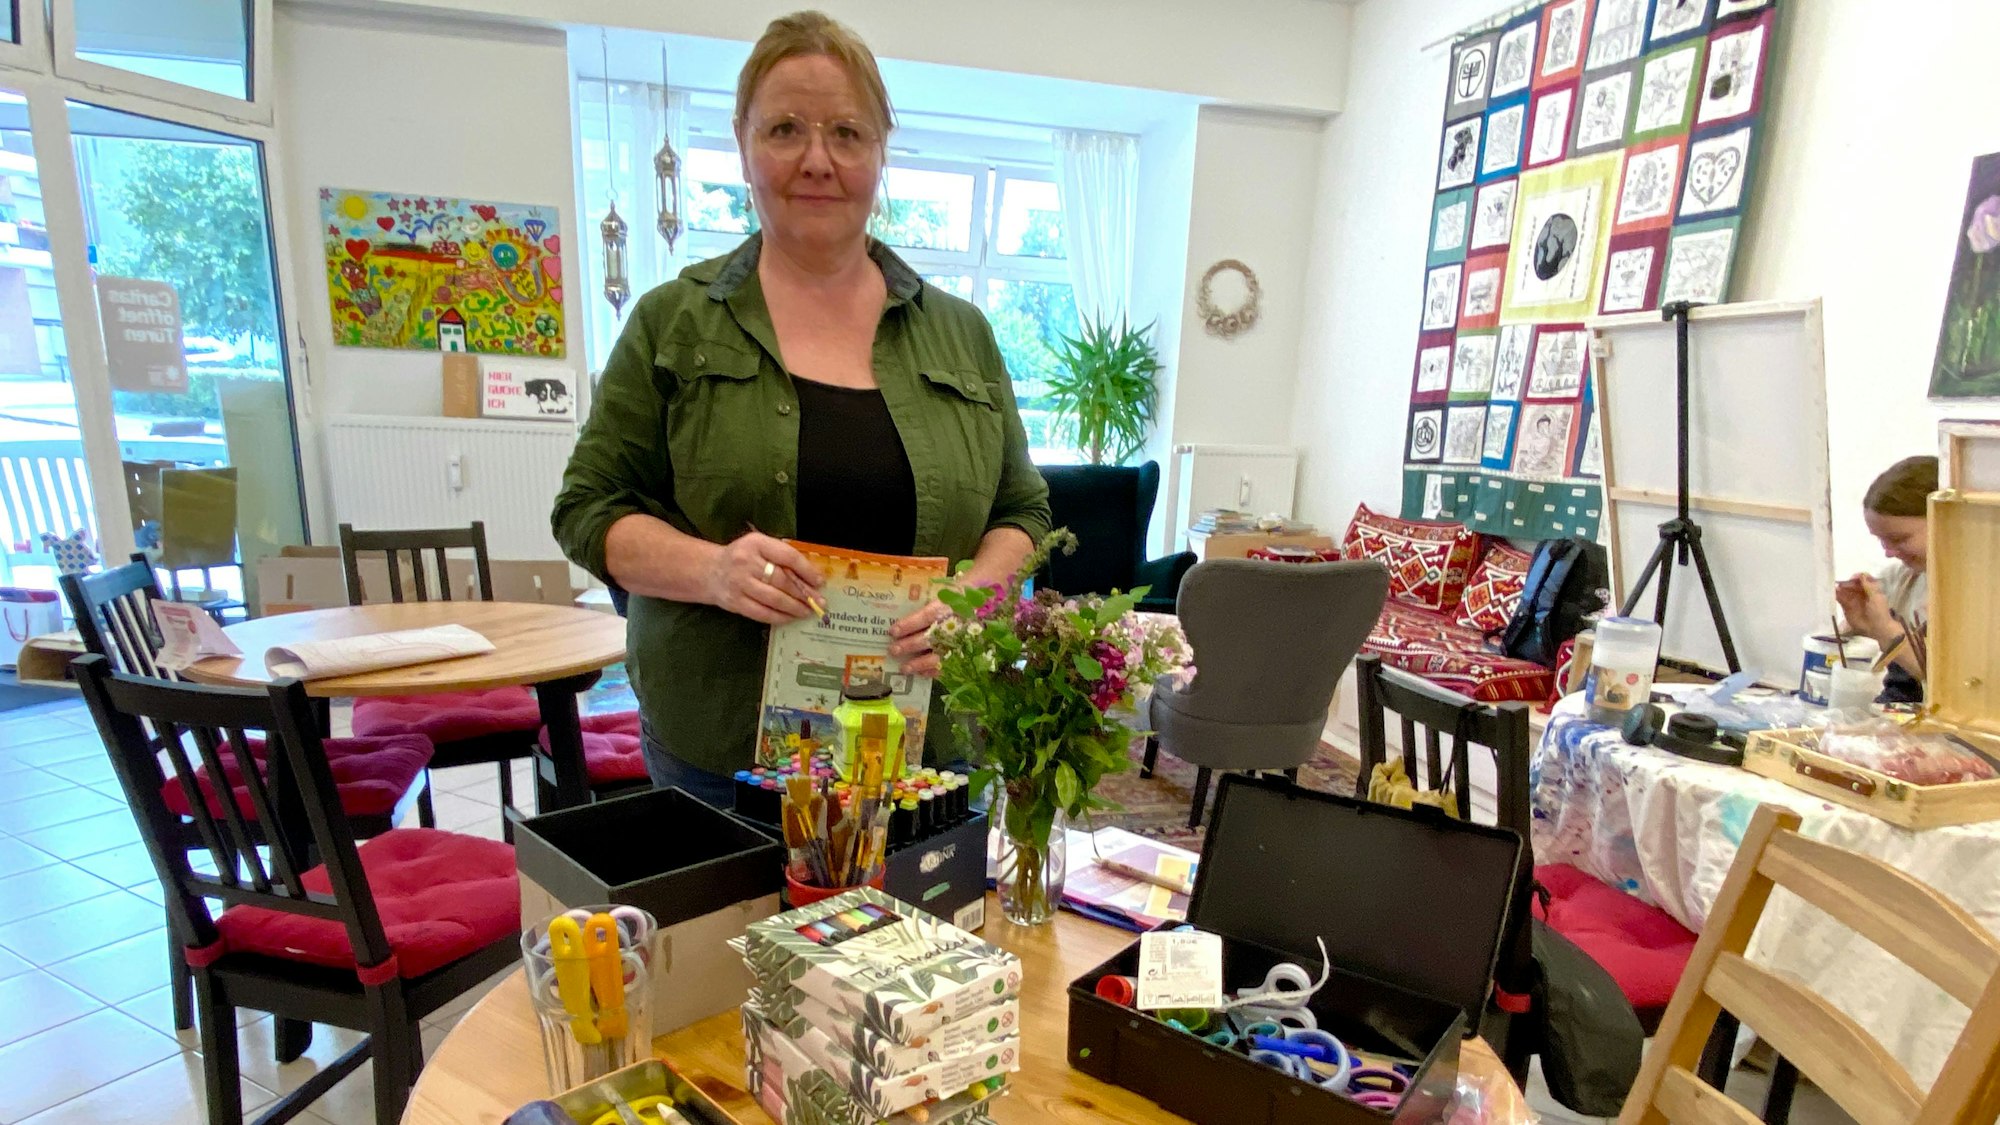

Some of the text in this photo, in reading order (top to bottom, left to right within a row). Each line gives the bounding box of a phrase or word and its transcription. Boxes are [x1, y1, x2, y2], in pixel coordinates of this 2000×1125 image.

[488, 371, 512, 382] HIER
[488, 385, 521, 396] GUCKE
[488, 398, 506, 409] ICH
[827, 610, 867, 623] ntdeckt
[870, 615, 886, 625] die
[838, 625, 868, 635] euren
